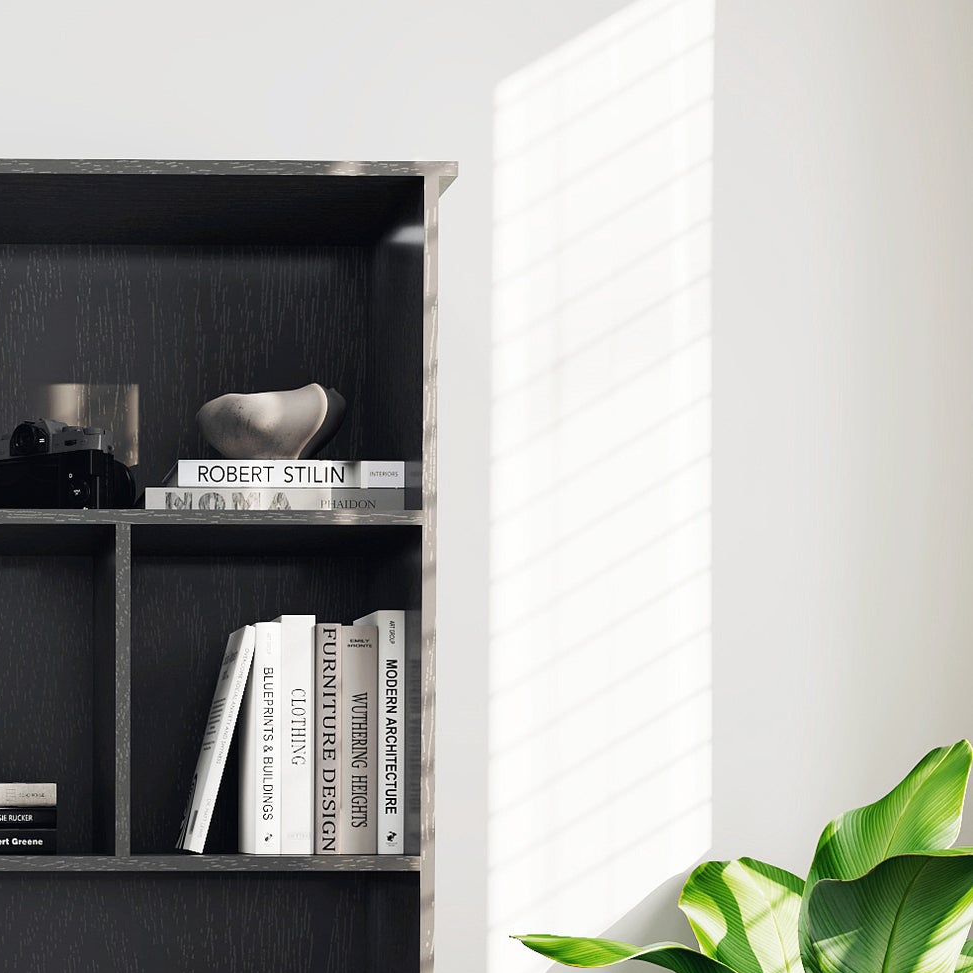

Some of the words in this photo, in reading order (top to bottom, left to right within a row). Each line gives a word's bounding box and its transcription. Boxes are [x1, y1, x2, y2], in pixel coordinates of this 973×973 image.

[198, 465, 275, 483] ROBERT
[283, 465, 345, 483] STILIN
[319, 499, 377, 510] PHAIDON
[262, 667, 274, 742] BLUEPRINTS
[322, 628, 337, 761] FURNITURE
[385, 659, 398, 714] MODERN
[262, 745, 274, 753] &
[291, 688, 307, 766] CLOTHING
[351, 692, 368, 769] WUTHERING
[262, 756, 274, 821] BUILDINGS
[384, 717, 398, 815] ARCHITECTURE
[8, 814, 33, 822] RUCKER
[322, 768, 336, 852] DESIGN
[351, 774, 368, 828] HEIGHTS
[11, 837, 44, 846] Greene
